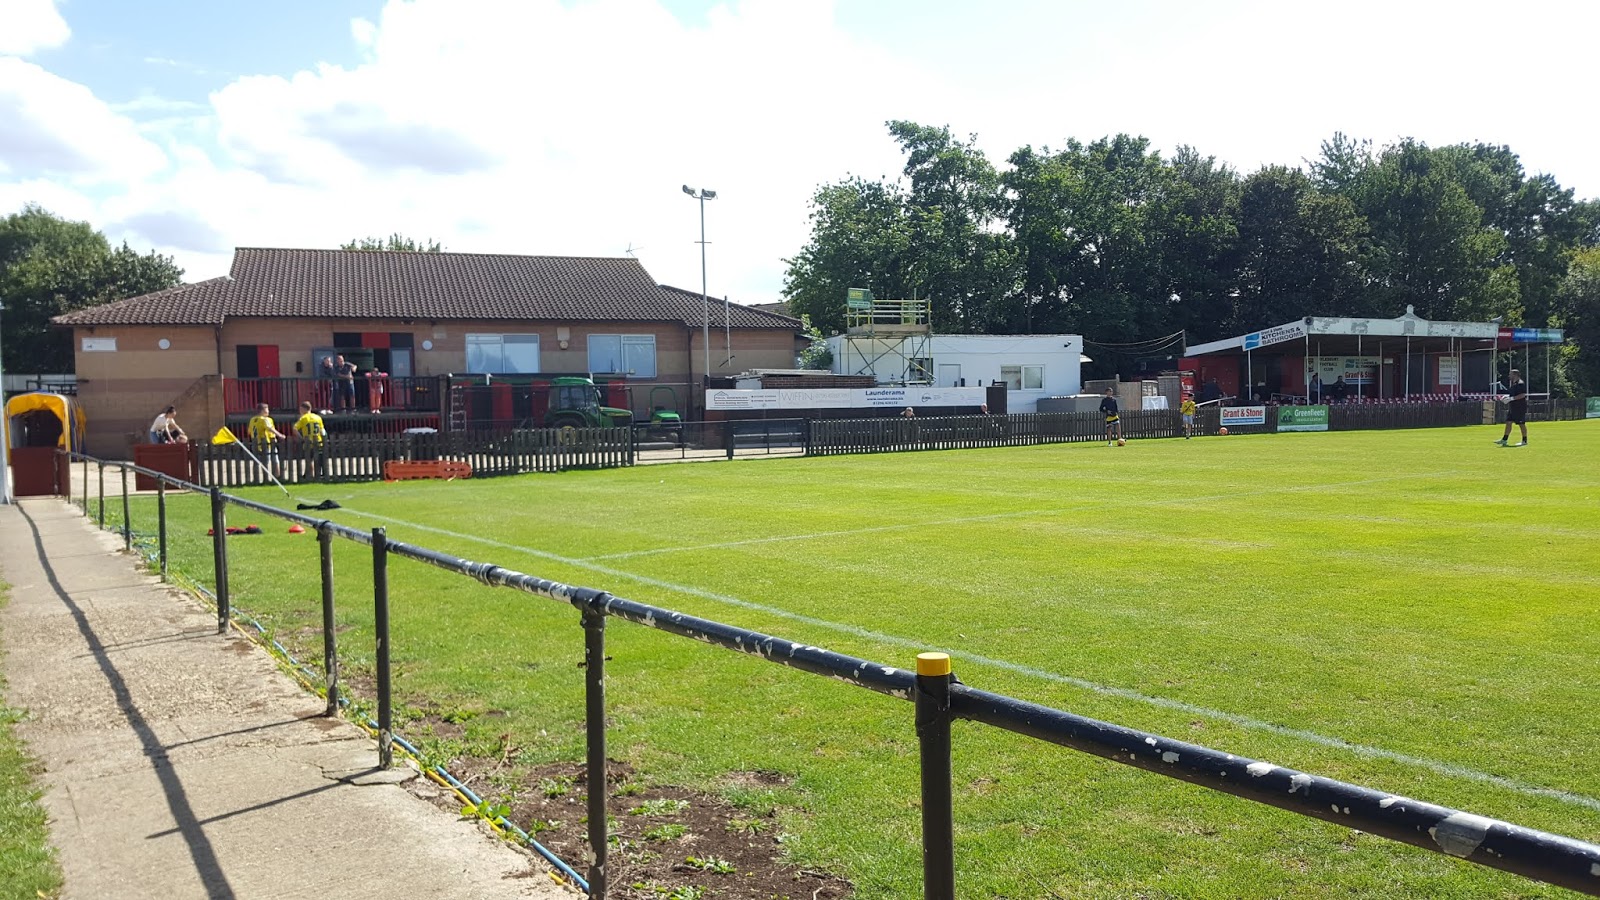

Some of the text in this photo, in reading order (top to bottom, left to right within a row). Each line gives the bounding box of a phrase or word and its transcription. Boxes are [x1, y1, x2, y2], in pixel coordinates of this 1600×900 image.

[1261, 327, 1294, 340] KITCHENS
[1262, 331, 1304, 345] BATHROOMS
[1222, 408, 1263, 417] Grant & Stone
[1294, 408, 1326, 417] Greenfleets
[305, 422, 320, 435] 15
